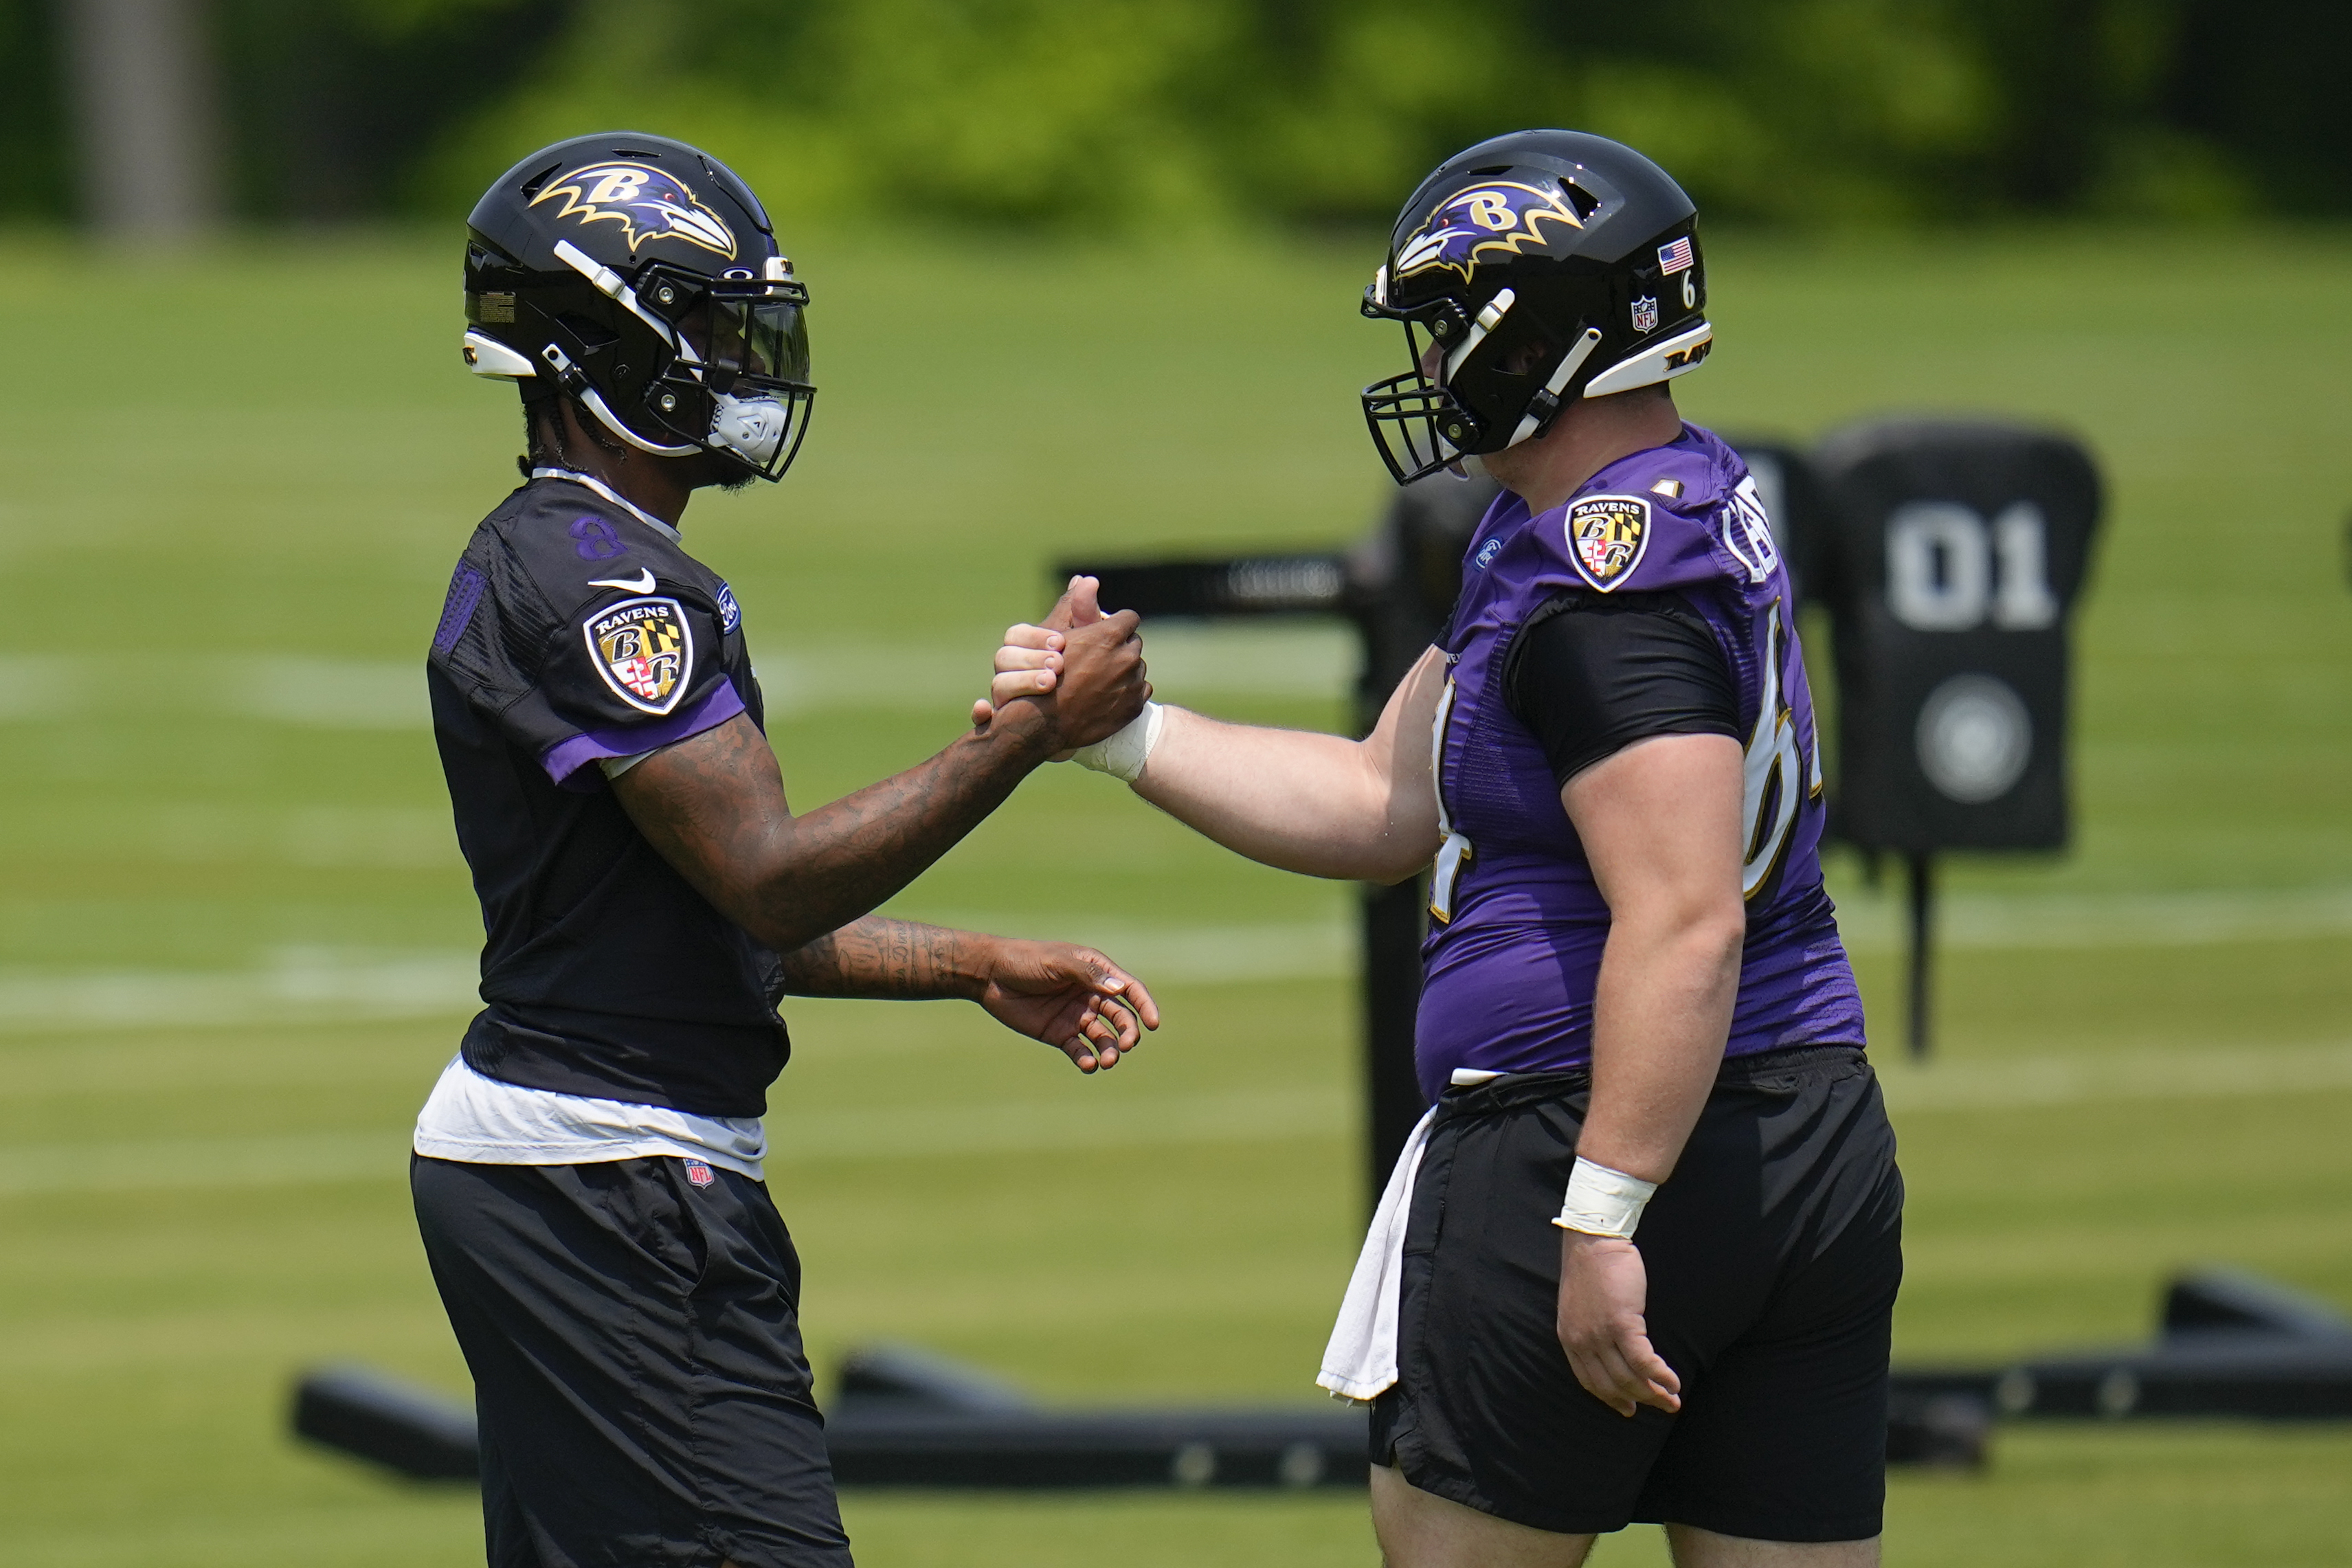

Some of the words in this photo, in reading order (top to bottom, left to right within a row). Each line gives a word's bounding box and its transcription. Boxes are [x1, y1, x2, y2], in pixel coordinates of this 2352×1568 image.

[1446, 191, 1518, 231] B
[1682, 269, 1696, 309] 6
[1637, 313, 1655, 327] NFL
[1575, 502, 1640, 516] RAVENS
[569, 516, 629, 561] 8
[1577, 513, 1610, 539] B
[1885, 500, 2060, 631] 01
[595, 606, 669, 635] RAVENS
[601, 625, 643, 662] B
[690, 1167, 711, 1183] NFL
